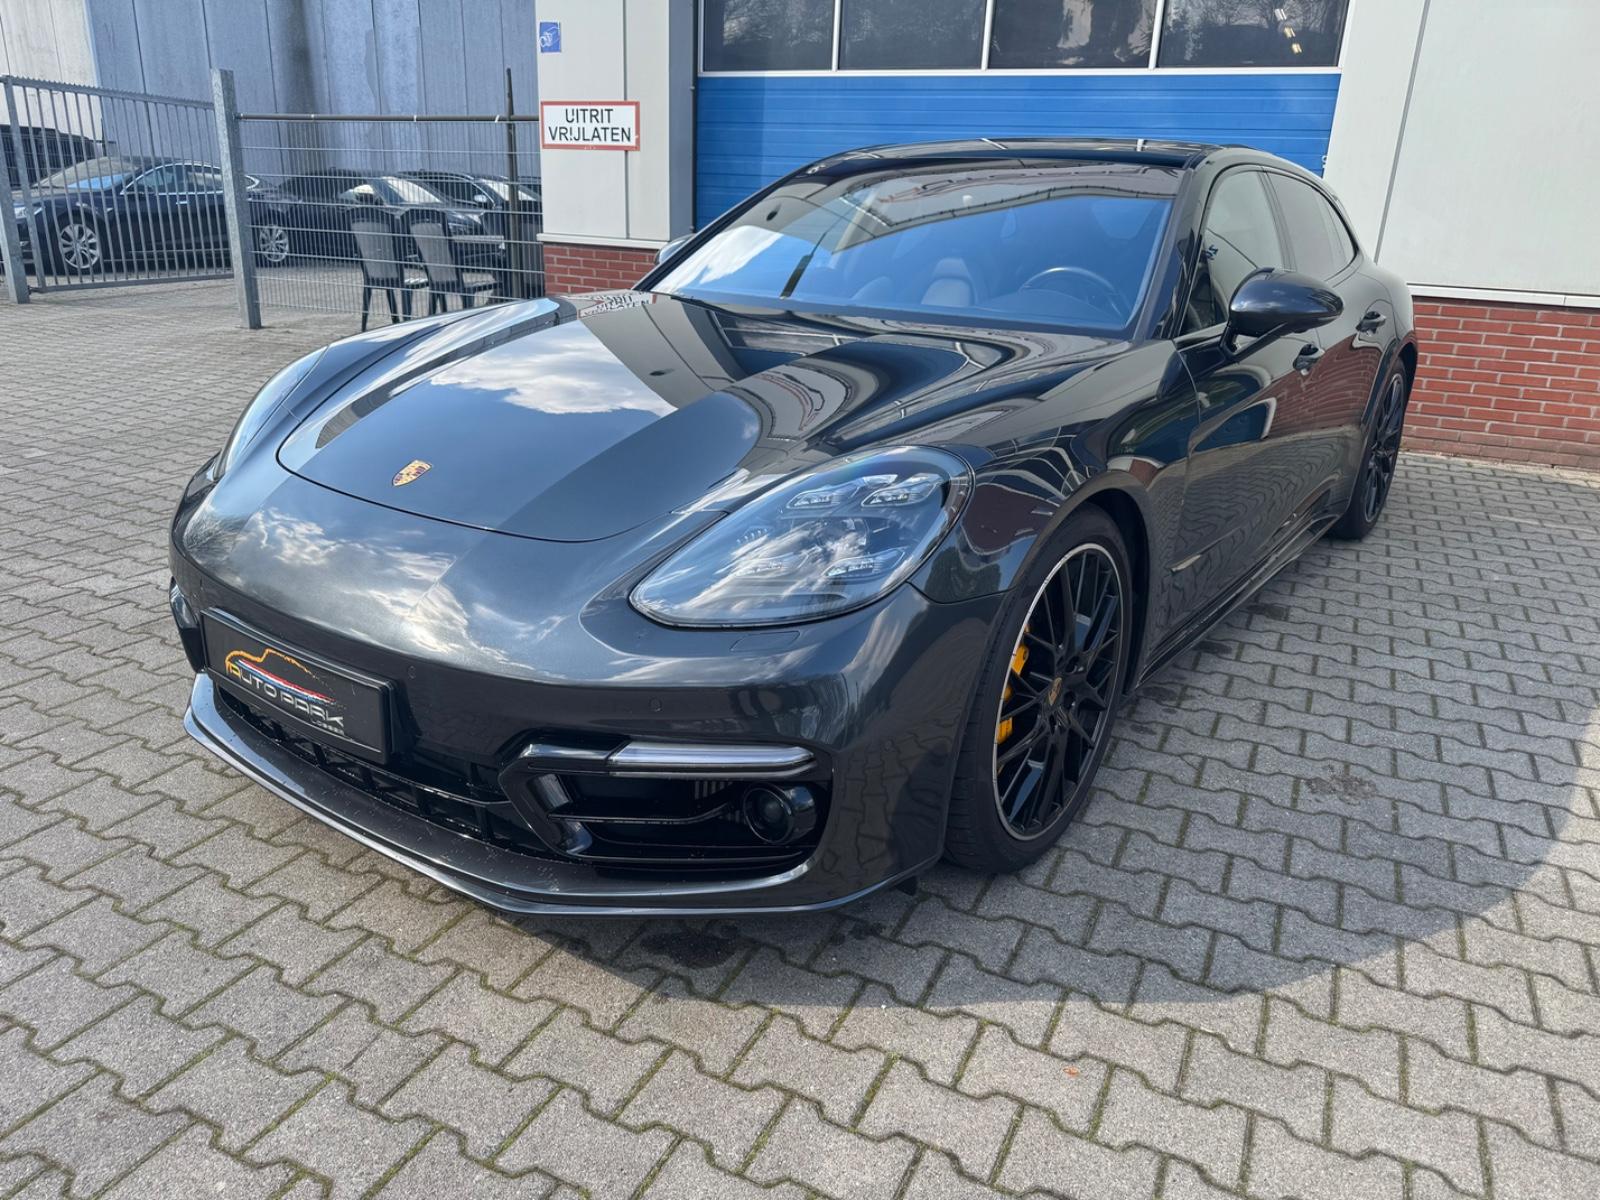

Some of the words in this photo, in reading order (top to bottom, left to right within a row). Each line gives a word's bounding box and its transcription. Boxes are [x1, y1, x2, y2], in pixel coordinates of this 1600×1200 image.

[565, 108, 614, 124] UITRIT
[548, 126, 632, 142] VRIJLATEN
[226, 661, 277, 698] AUTO
[280, 690, 345, 728] PARK
